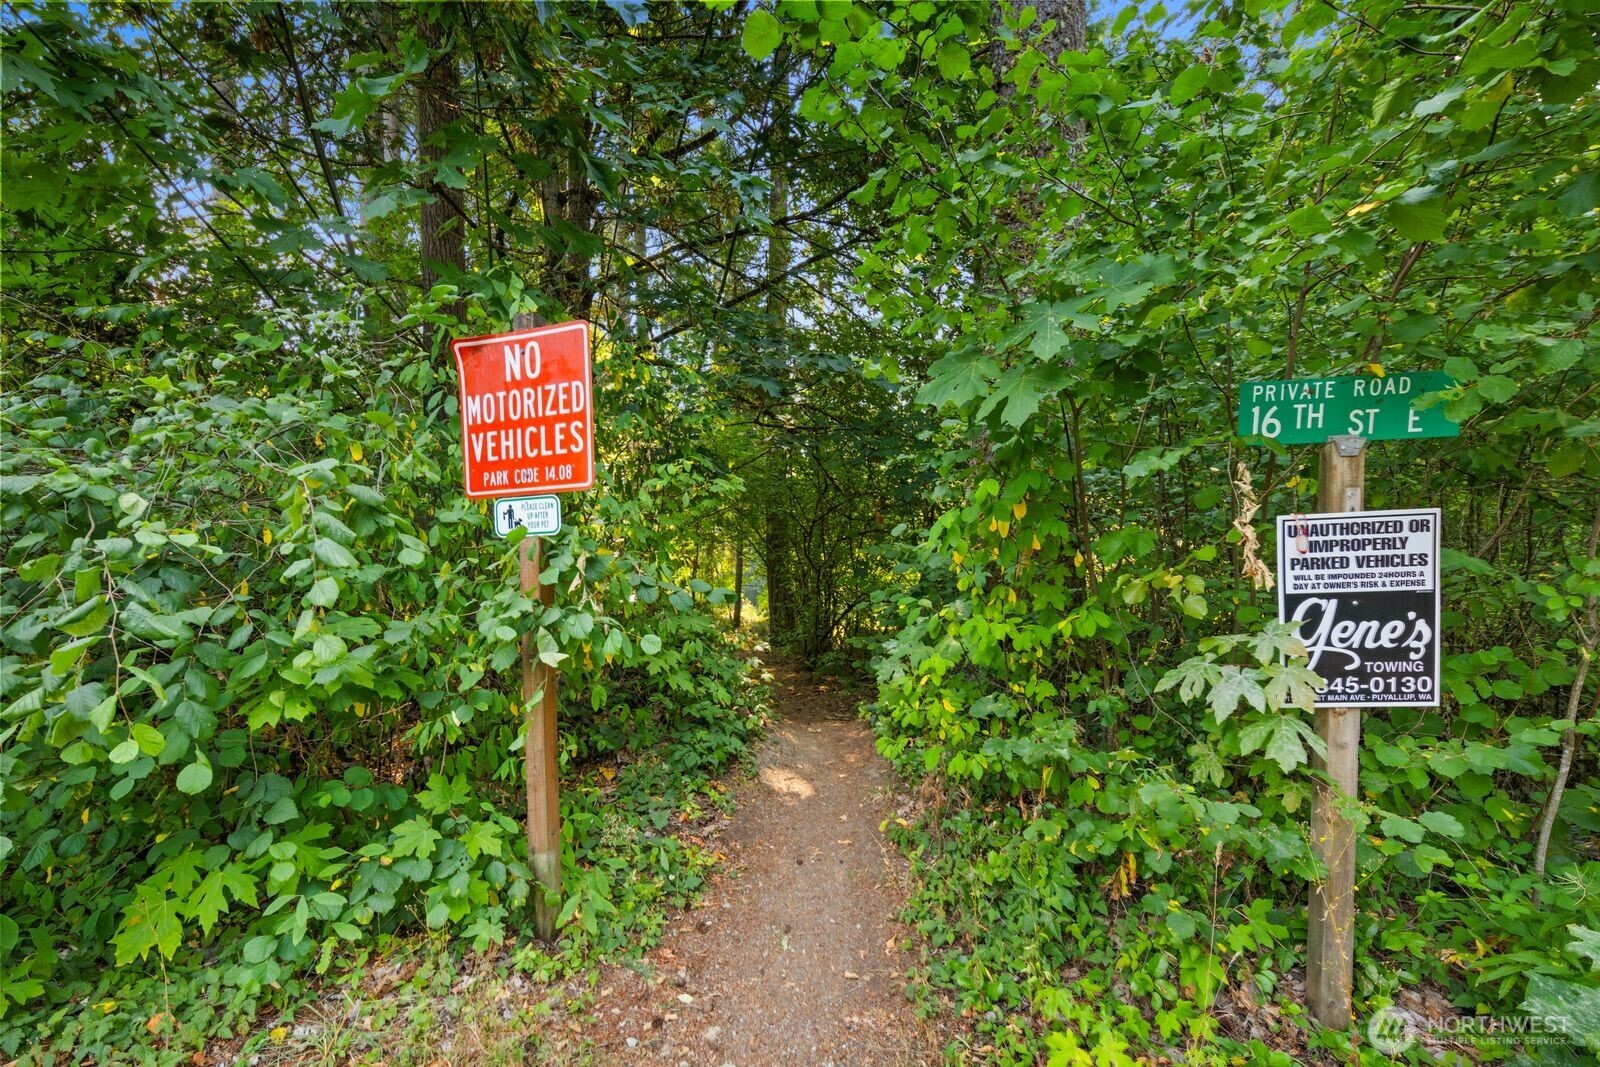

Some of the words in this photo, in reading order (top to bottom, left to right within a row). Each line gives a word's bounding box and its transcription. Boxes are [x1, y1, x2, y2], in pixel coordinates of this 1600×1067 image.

[504, 341, 542, 382] NO
[1252, 381, 1336, 402] PRIVATE
[1353, 376, 1412, 397] ROAD
[467, 381, 585, 426] MOTORIZED
[1251, 405, 1282, 438] 16
[1293, 403, 1325, 429] TH
[1347, 408, 1380, 435] ST
[1408, 406, 1423, 433] E
[470, 421, 585, 463] VEHICLES
[483, 470, 509, 487] PARK
[514, 467, 539, 484] CODE
[545, 464, 573, 481] 14.08
[521, 502, 538, 511] PLEASE
[539, 501, 554, 509] CLEAN
[527, 512, 534, 520] UP
[534, 511, 548, 519] AFTER
[527, 521, 540, 529] YOUR
[1409, 519, 1431, 533] OR
[1308, 536, 1409, 553] IMPROPERLY
[1290, 556, 1350, 571] PARKED
[1355, 553, 1429, 569] VEHICLES
[1328, 572, 1376, 580] IMPOUNDED
[1390, 580, 1426, 588] EXPENSE
[1291, 597, 1433, 671] Gene's
[1364, 661, 1424, 673] TOWING
[1372, 694, 1417, 702] PUYALLUP,
